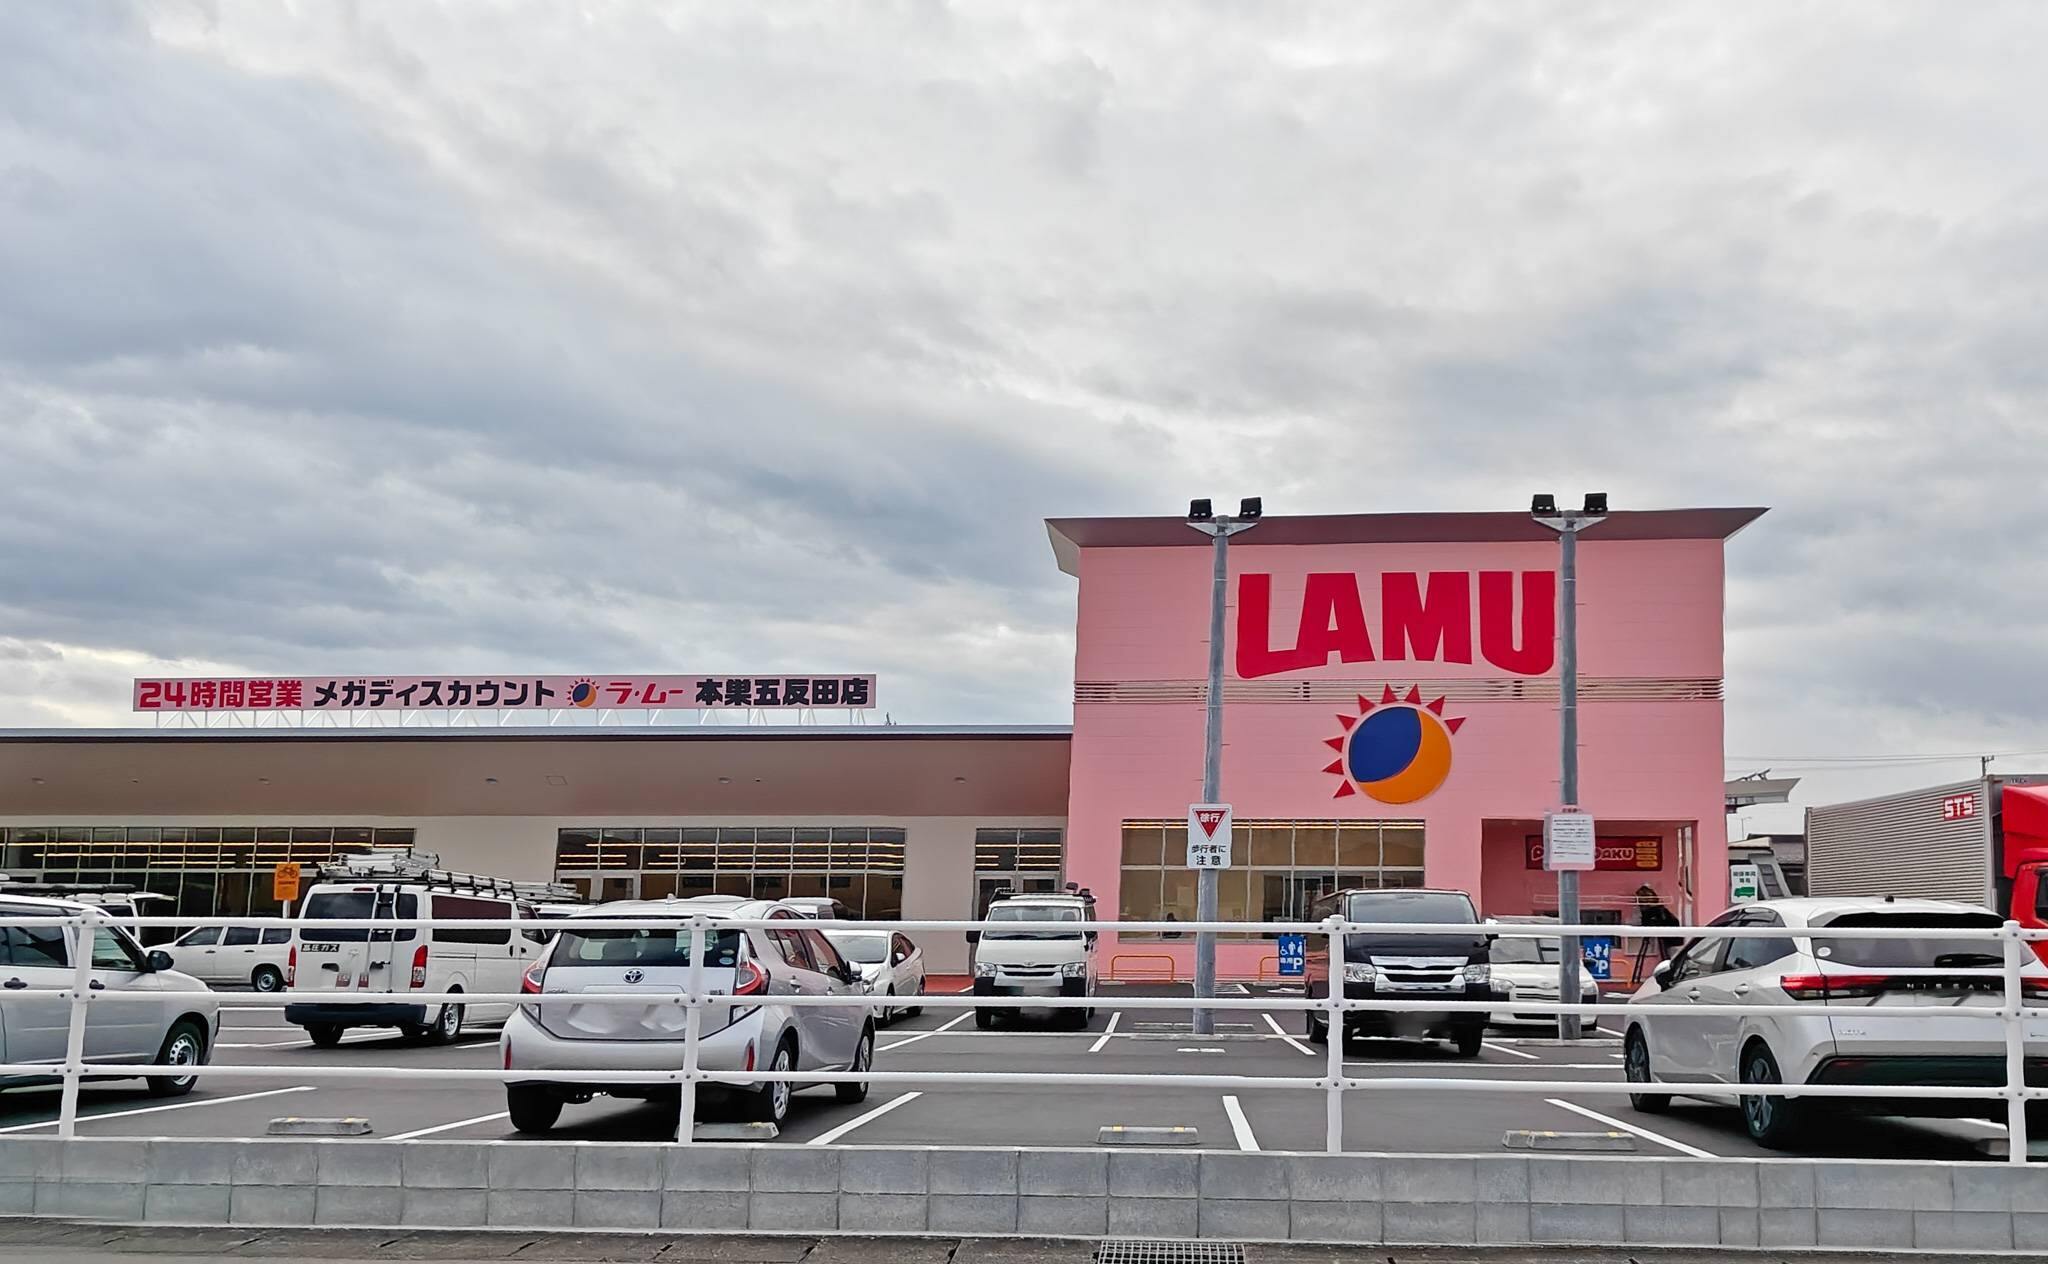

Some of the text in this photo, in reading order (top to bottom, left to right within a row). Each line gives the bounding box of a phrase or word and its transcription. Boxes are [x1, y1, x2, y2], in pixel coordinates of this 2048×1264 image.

[1236, 570, 1556, 679] LAMU
[139, 679, 303, 709] 24時間営業
[313, 678, 556, 707] メガディスカウント
[695, 677, 869, 707] 本巣五反田店
[1944, 796, 1974, 818] STS
[1191, 844, 1227, 854] 歩行者に
[1906, 982, 1991, 991] NISSAN
